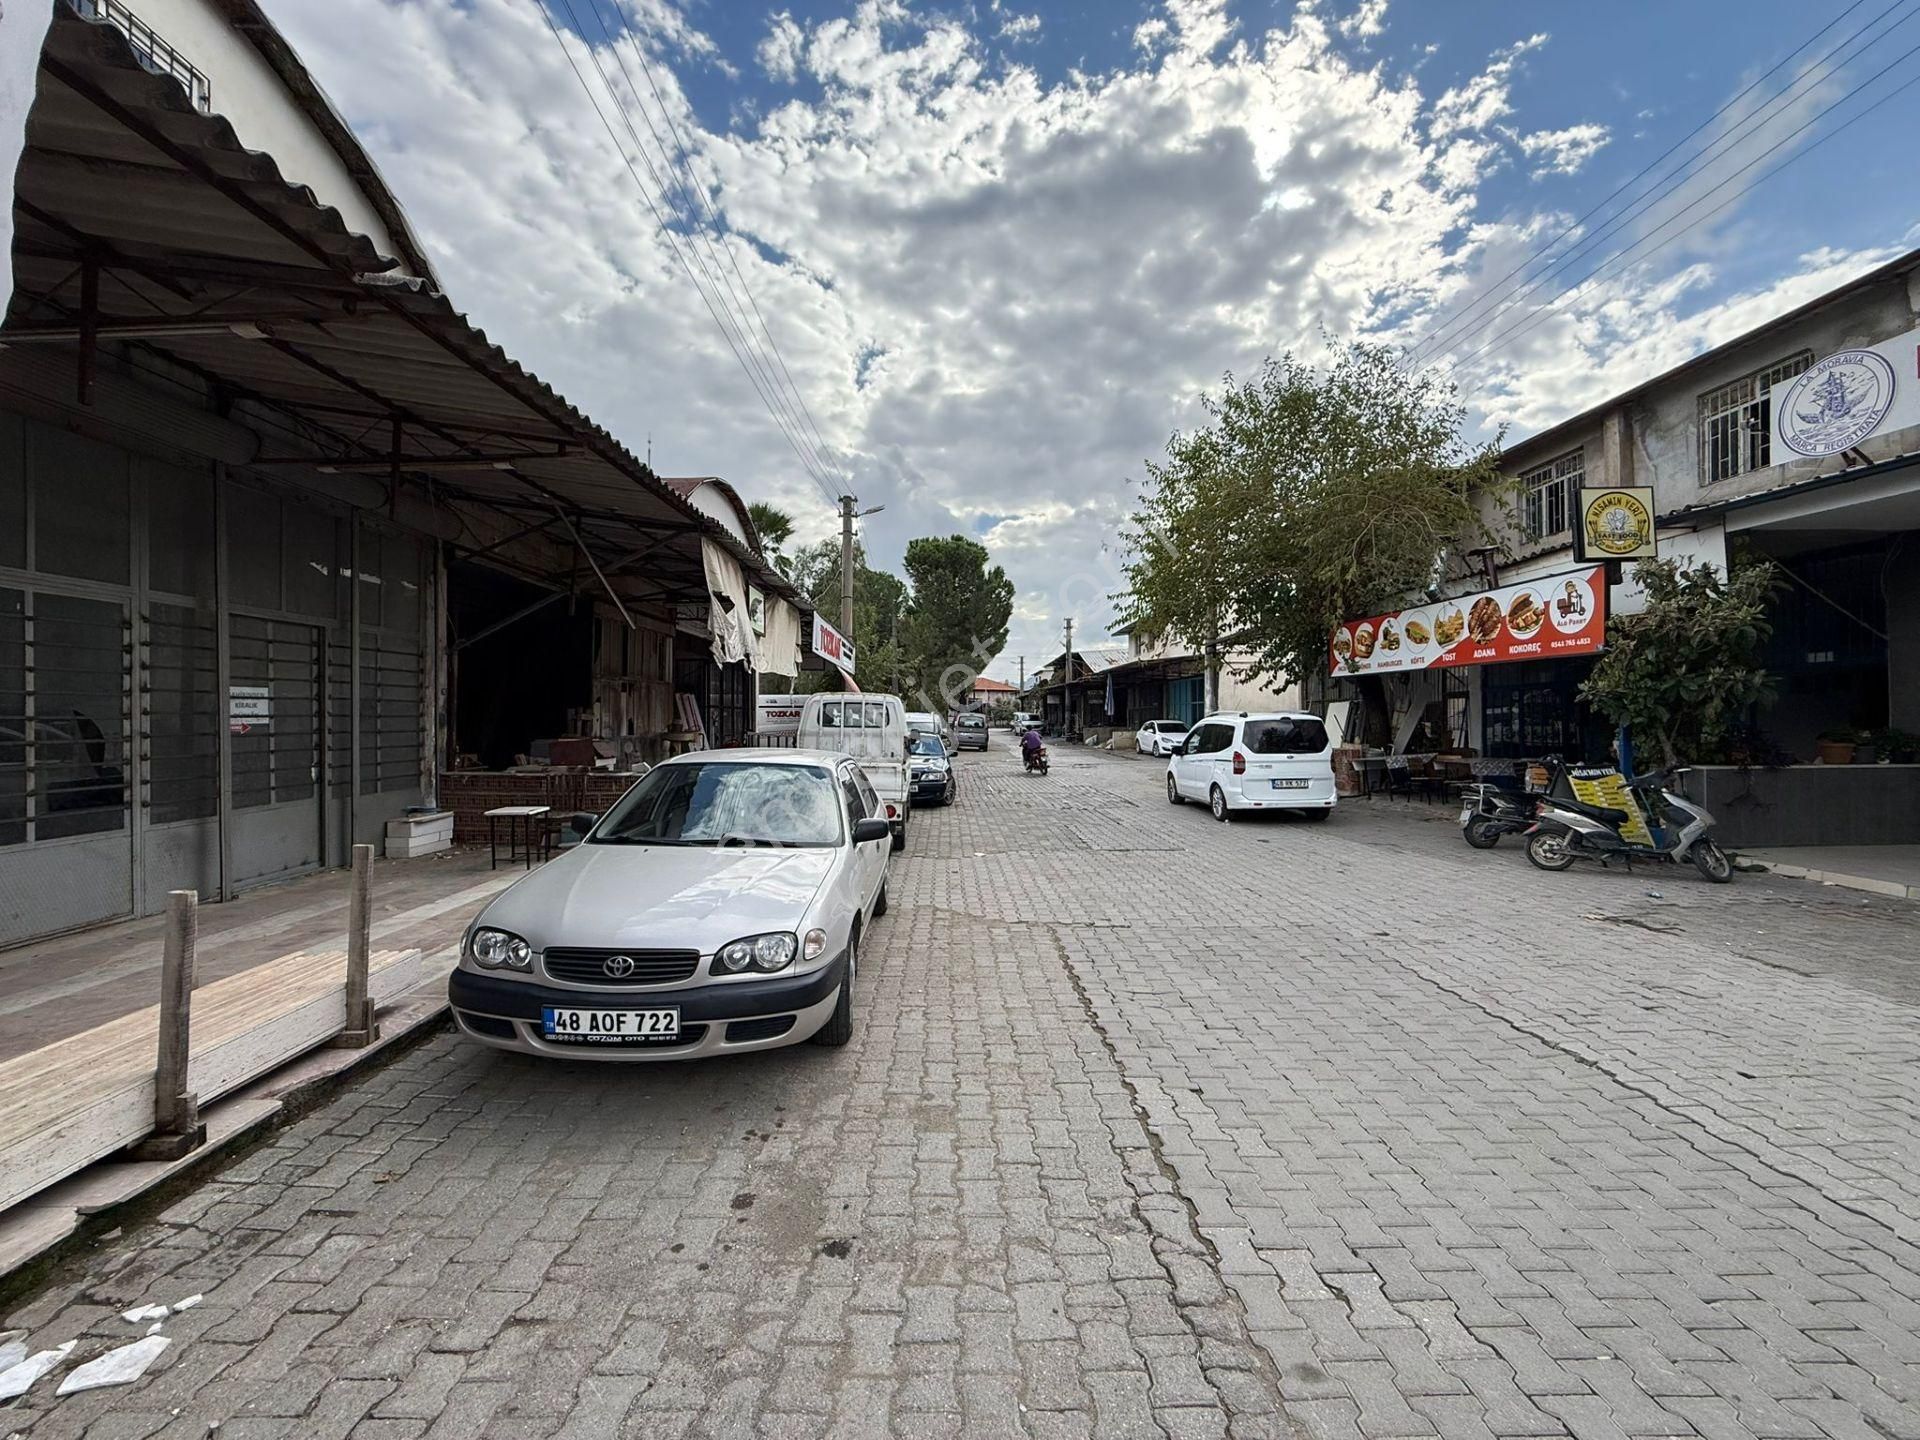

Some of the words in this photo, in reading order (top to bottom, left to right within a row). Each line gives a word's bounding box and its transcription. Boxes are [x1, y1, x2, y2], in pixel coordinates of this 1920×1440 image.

[1800, 375, 1814, 388] LA
[1817, 355, 1865, 375] MORAVIA
[1789, 434, 1817, 452] MARCA
[1824, 408, 1882, 451] REGISTRATA
[1618, 532, 1639, 540] FOOD
[1473, 648, 1496, 659] ADANA
[1509, 643, 1542, 655] KOKOREÇ
[1410, 656, 1425, 665] KÖFTE
[1442, 652, 1456, 662] TOST
[556, 1011, 580, 1031] 48
[589, 1012, 627, 1032] AOF
[635, 1012, 675, 1032] 722
